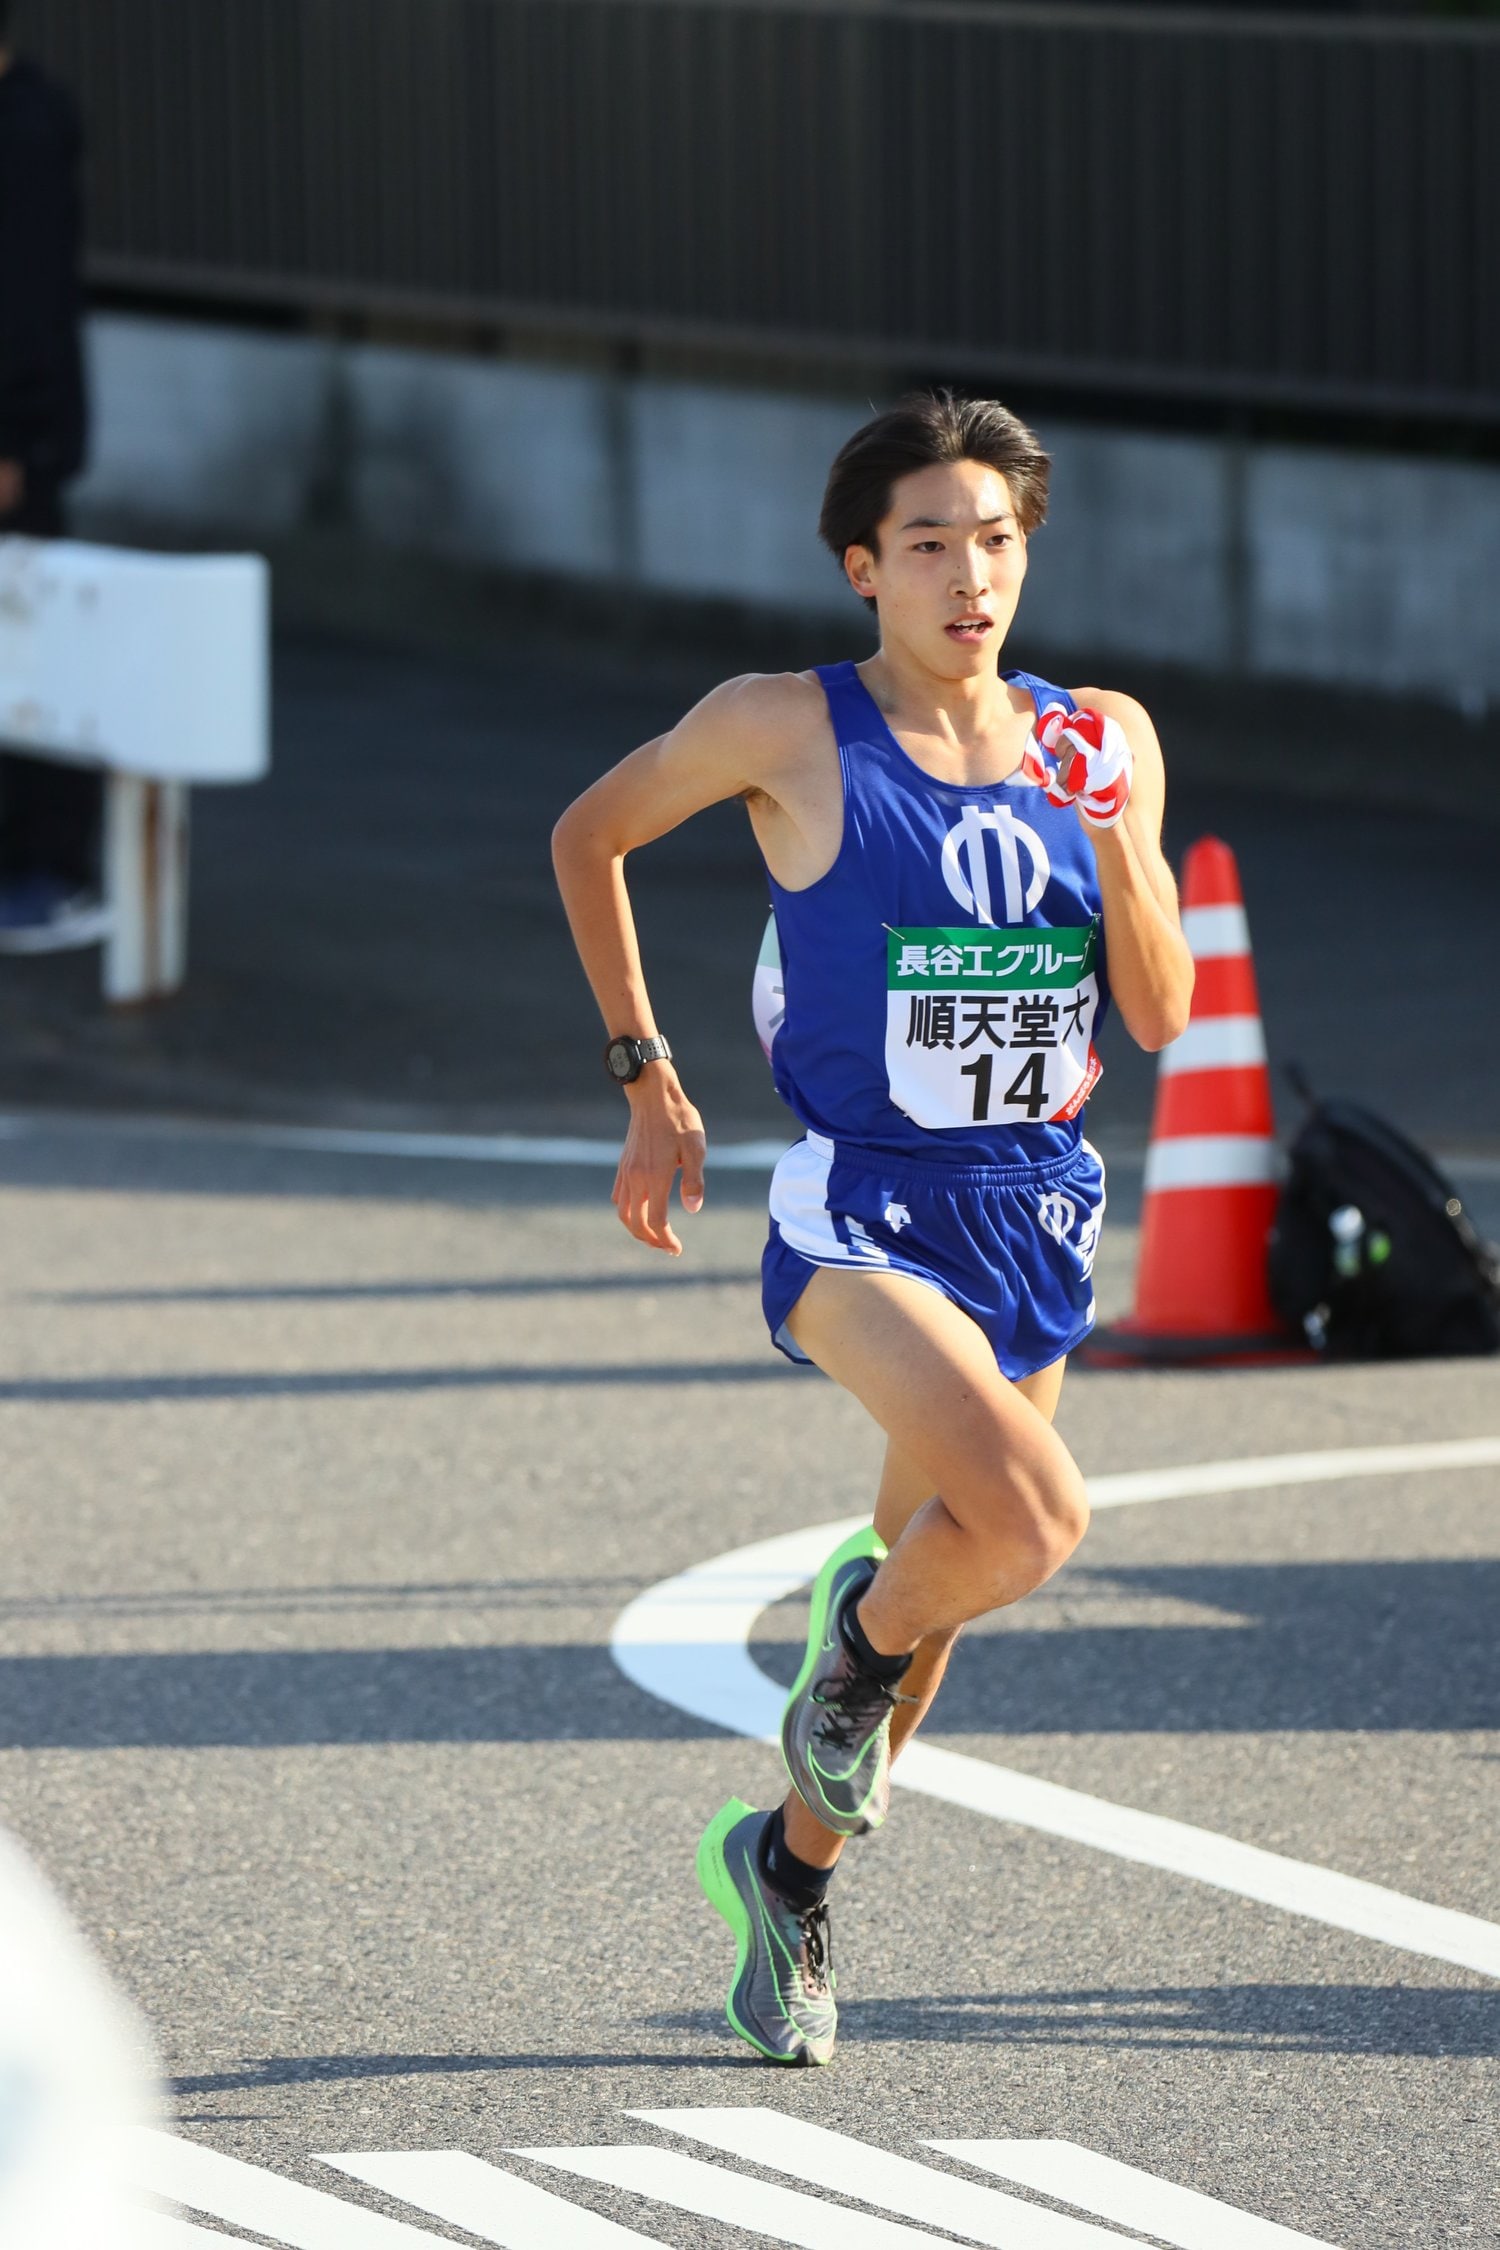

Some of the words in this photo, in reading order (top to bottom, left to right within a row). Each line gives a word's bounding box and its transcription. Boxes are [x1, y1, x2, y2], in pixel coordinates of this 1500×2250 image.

[906, 989, 1090, 1050] 順天堂大
[960, 1052, 1049, 1121] 14
